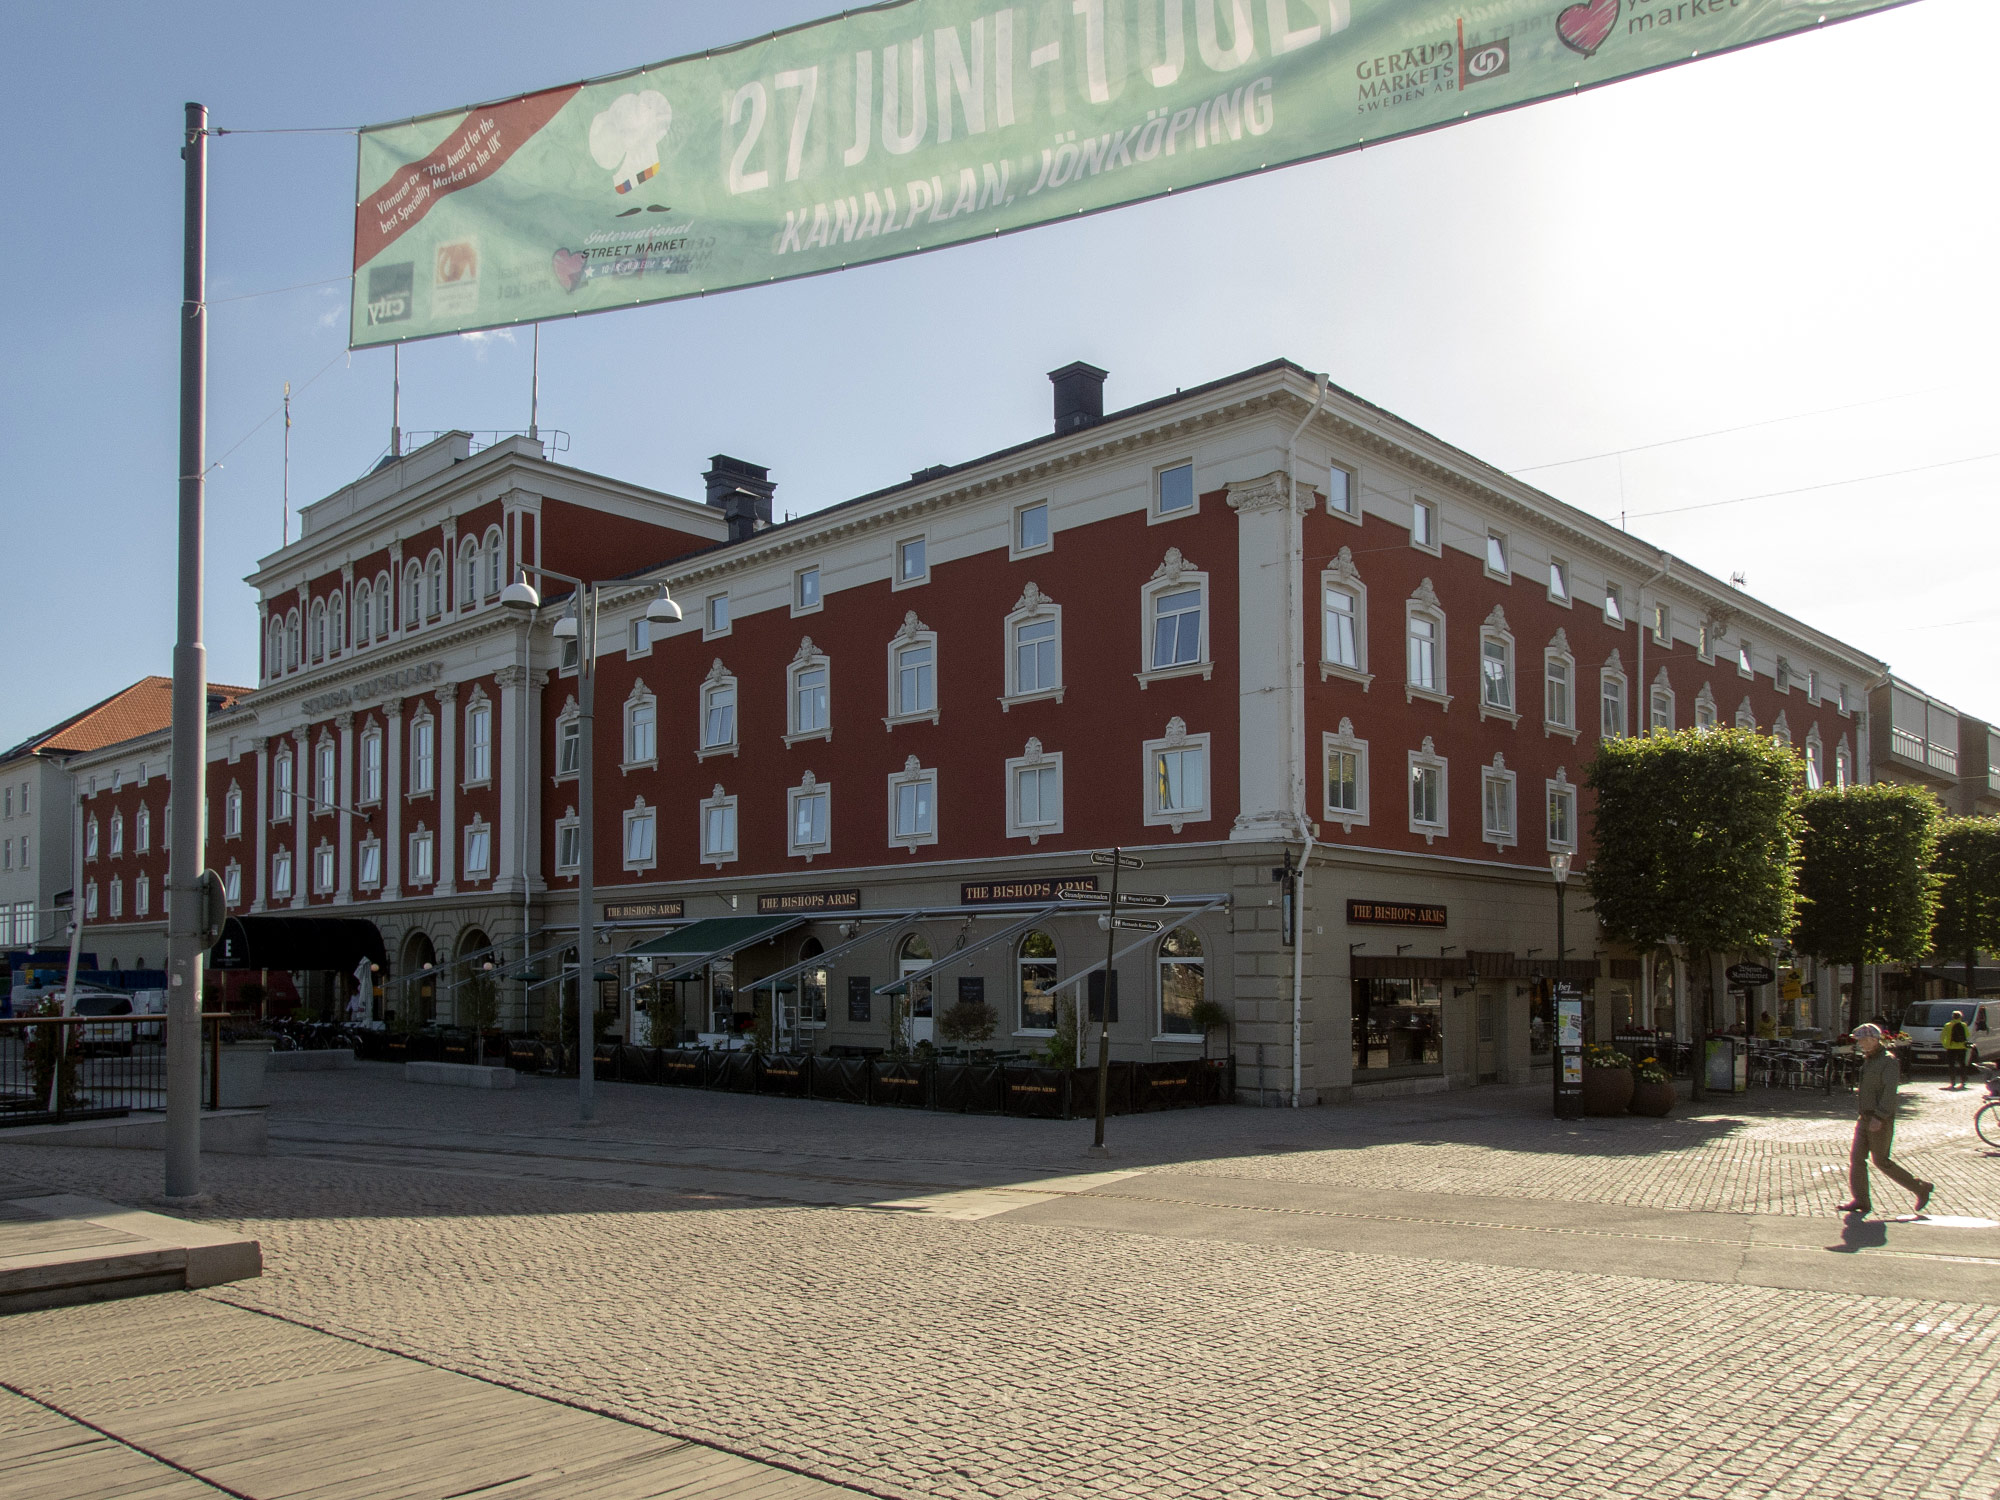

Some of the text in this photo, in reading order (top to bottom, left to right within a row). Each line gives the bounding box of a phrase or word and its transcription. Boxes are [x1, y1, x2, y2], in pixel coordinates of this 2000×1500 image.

[1357, 62, 1454, 101] MARKETS
[729, 65, 818, 195] 27
[1152, 0, 1350, 88] JU
[1357, 79, 1454, 114] SWEDEN AB
[376, 182, 410, 215] Vinnaren
[409, 173, 420, 186] av
[446, 137, 472, 168] Award
[467, 130, 482, 146] for
[480, 118, 495, 136] the
[778, 76, 1274, 255] KANALPLAN, JÖNKÖPING
[380, 214, 398, 234] best
[397, 184, 430, 220] Speciality
[432, 168, 467, 190] Market
[468, 163, 478, 175] in
[475, 150, 491, 165] the
[584, 220, 695, 245] International
[581, 245, 632, 259] STREET
[635, 239, 688, 254] MARKET
[761, 893, 857, 909] THE BISHOPS ARMS
[966, 880, 1094, 898] THE BISHOPS ARMS
[1064, 891, 1108, 900] Strandpromenaden
[608, 903, 681, 917] THE BISHOPS ARMS
[1353, 904, 1445, 922] THE BISHOPS ARMS
